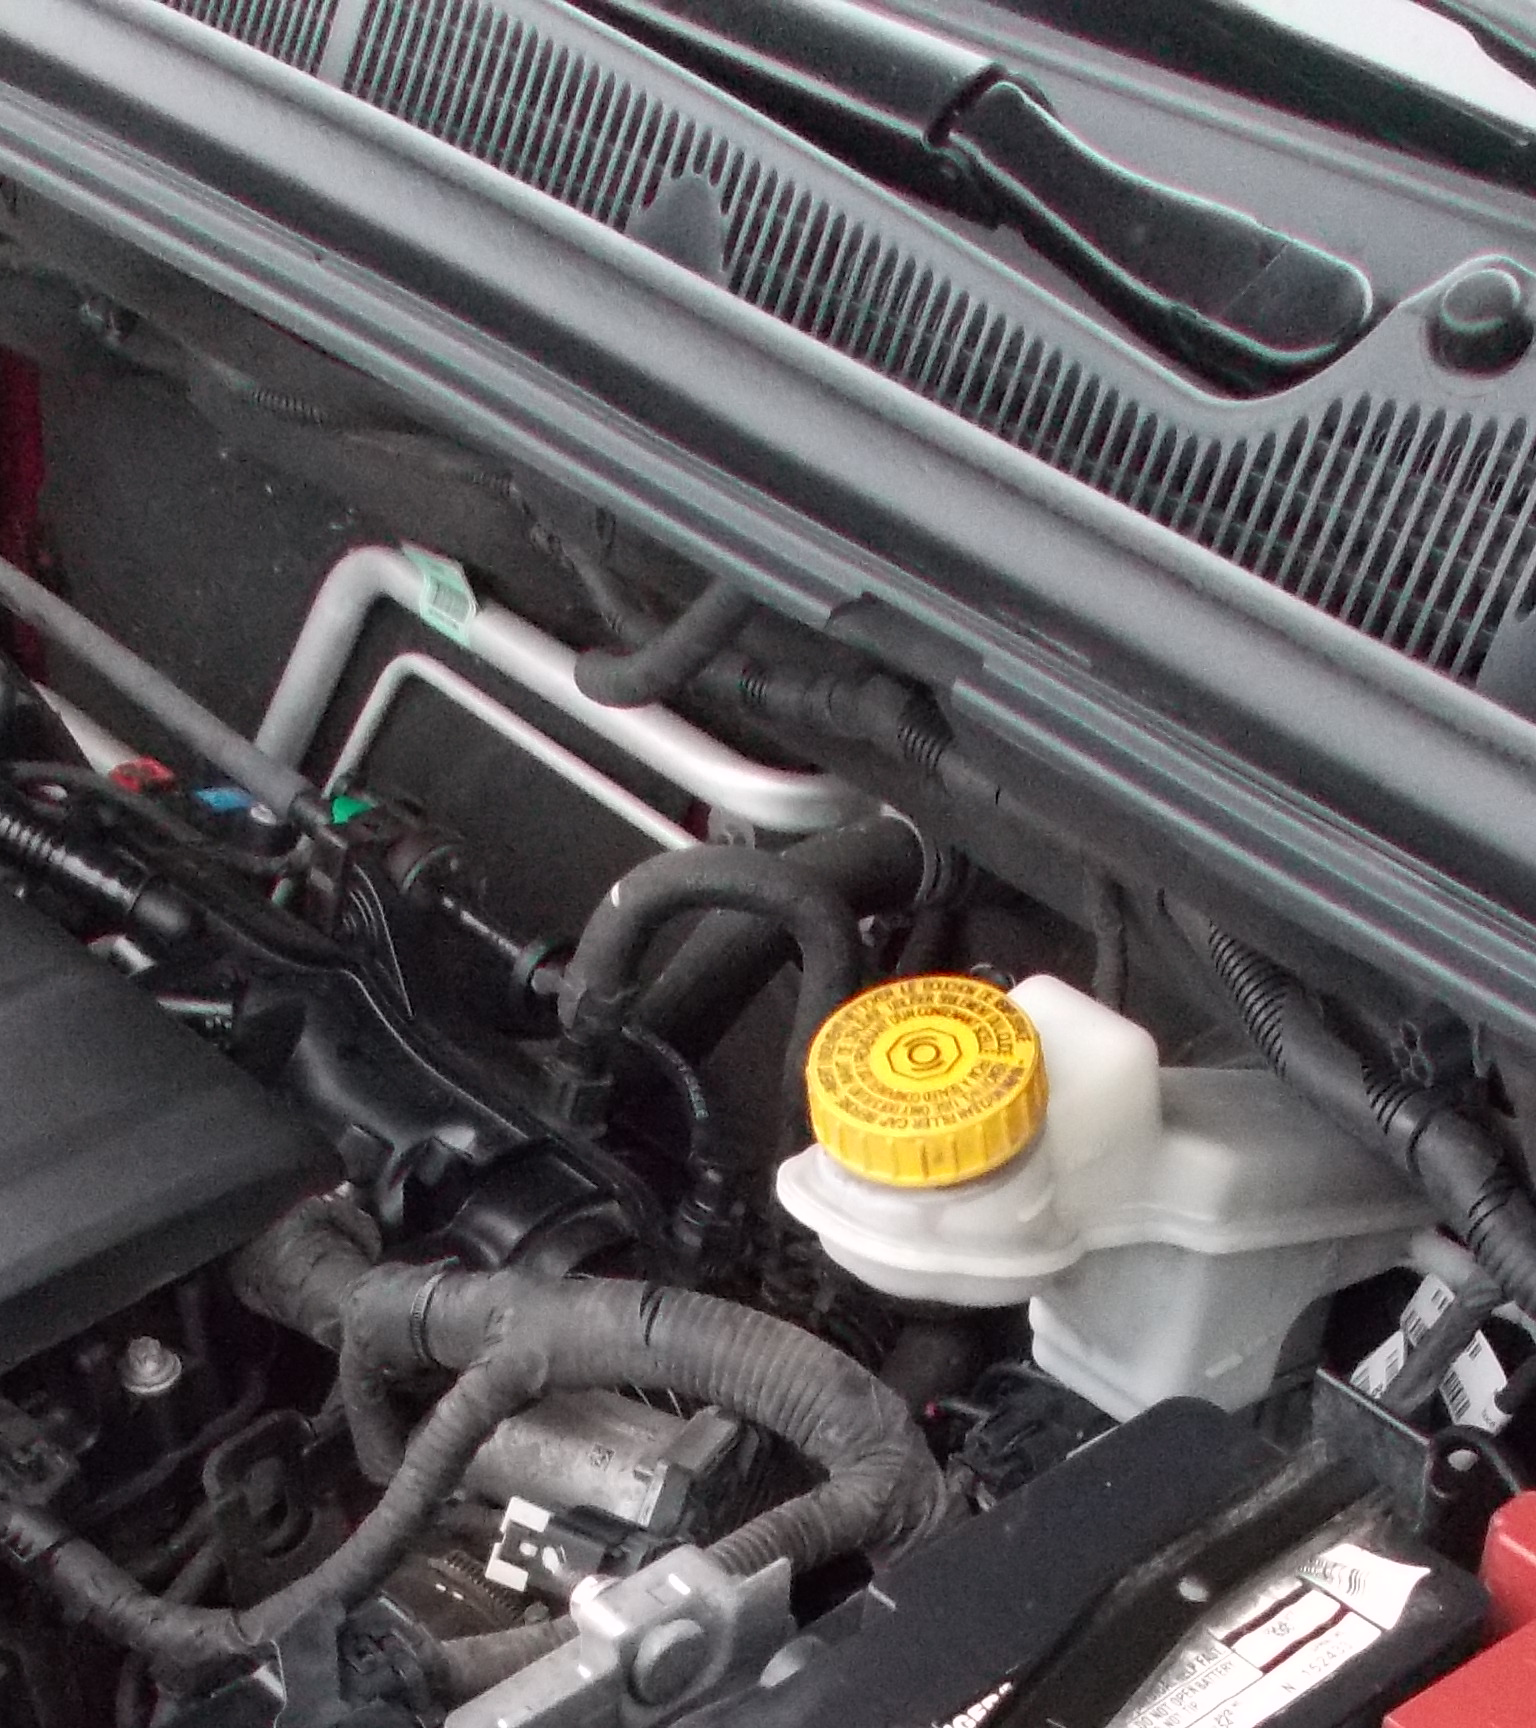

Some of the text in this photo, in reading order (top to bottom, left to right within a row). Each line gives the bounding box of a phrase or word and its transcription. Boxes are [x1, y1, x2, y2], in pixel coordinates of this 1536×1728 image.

[1153, 1702, 1172, 1721] NOT
[1169, 1685, 1200, 1708] OPEN
[1197, 1660, 1235, 1692] BATTERY
